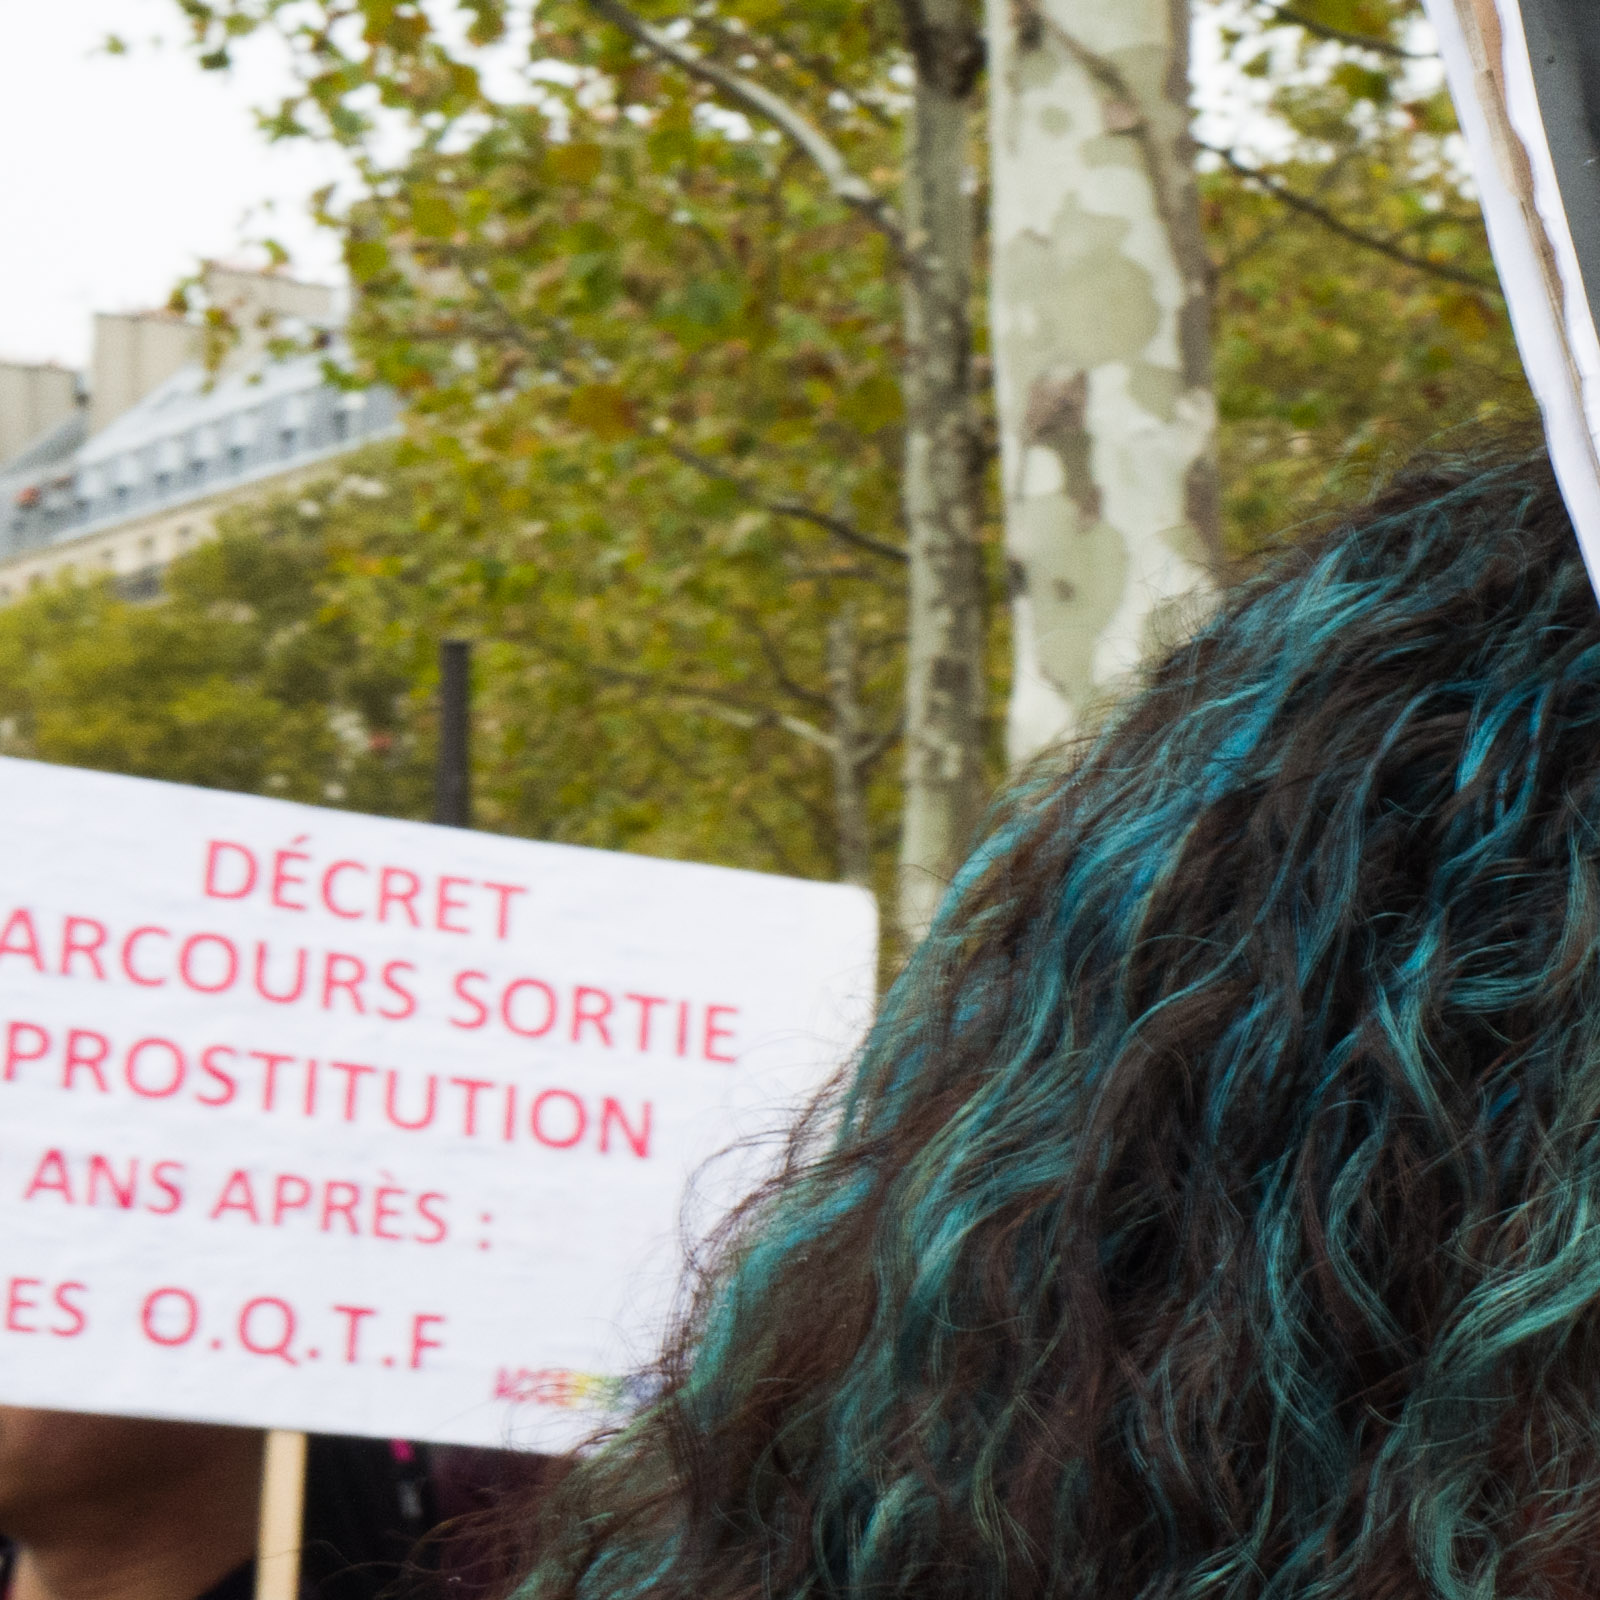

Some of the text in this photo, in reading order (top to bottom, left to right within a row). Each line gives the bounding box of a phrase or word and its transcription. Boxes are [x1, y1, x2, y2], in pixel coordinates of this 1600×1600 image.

[202, 834, 527, 941] DÉCRET
[0, 906, 739, 1066] ARCOURS SORTIE
[2, 1019, 654, 1160] PROSTITUTION
[23, 1147, 186, 1216] ANS
[209, 1168, 449, 1246] APRÈS
